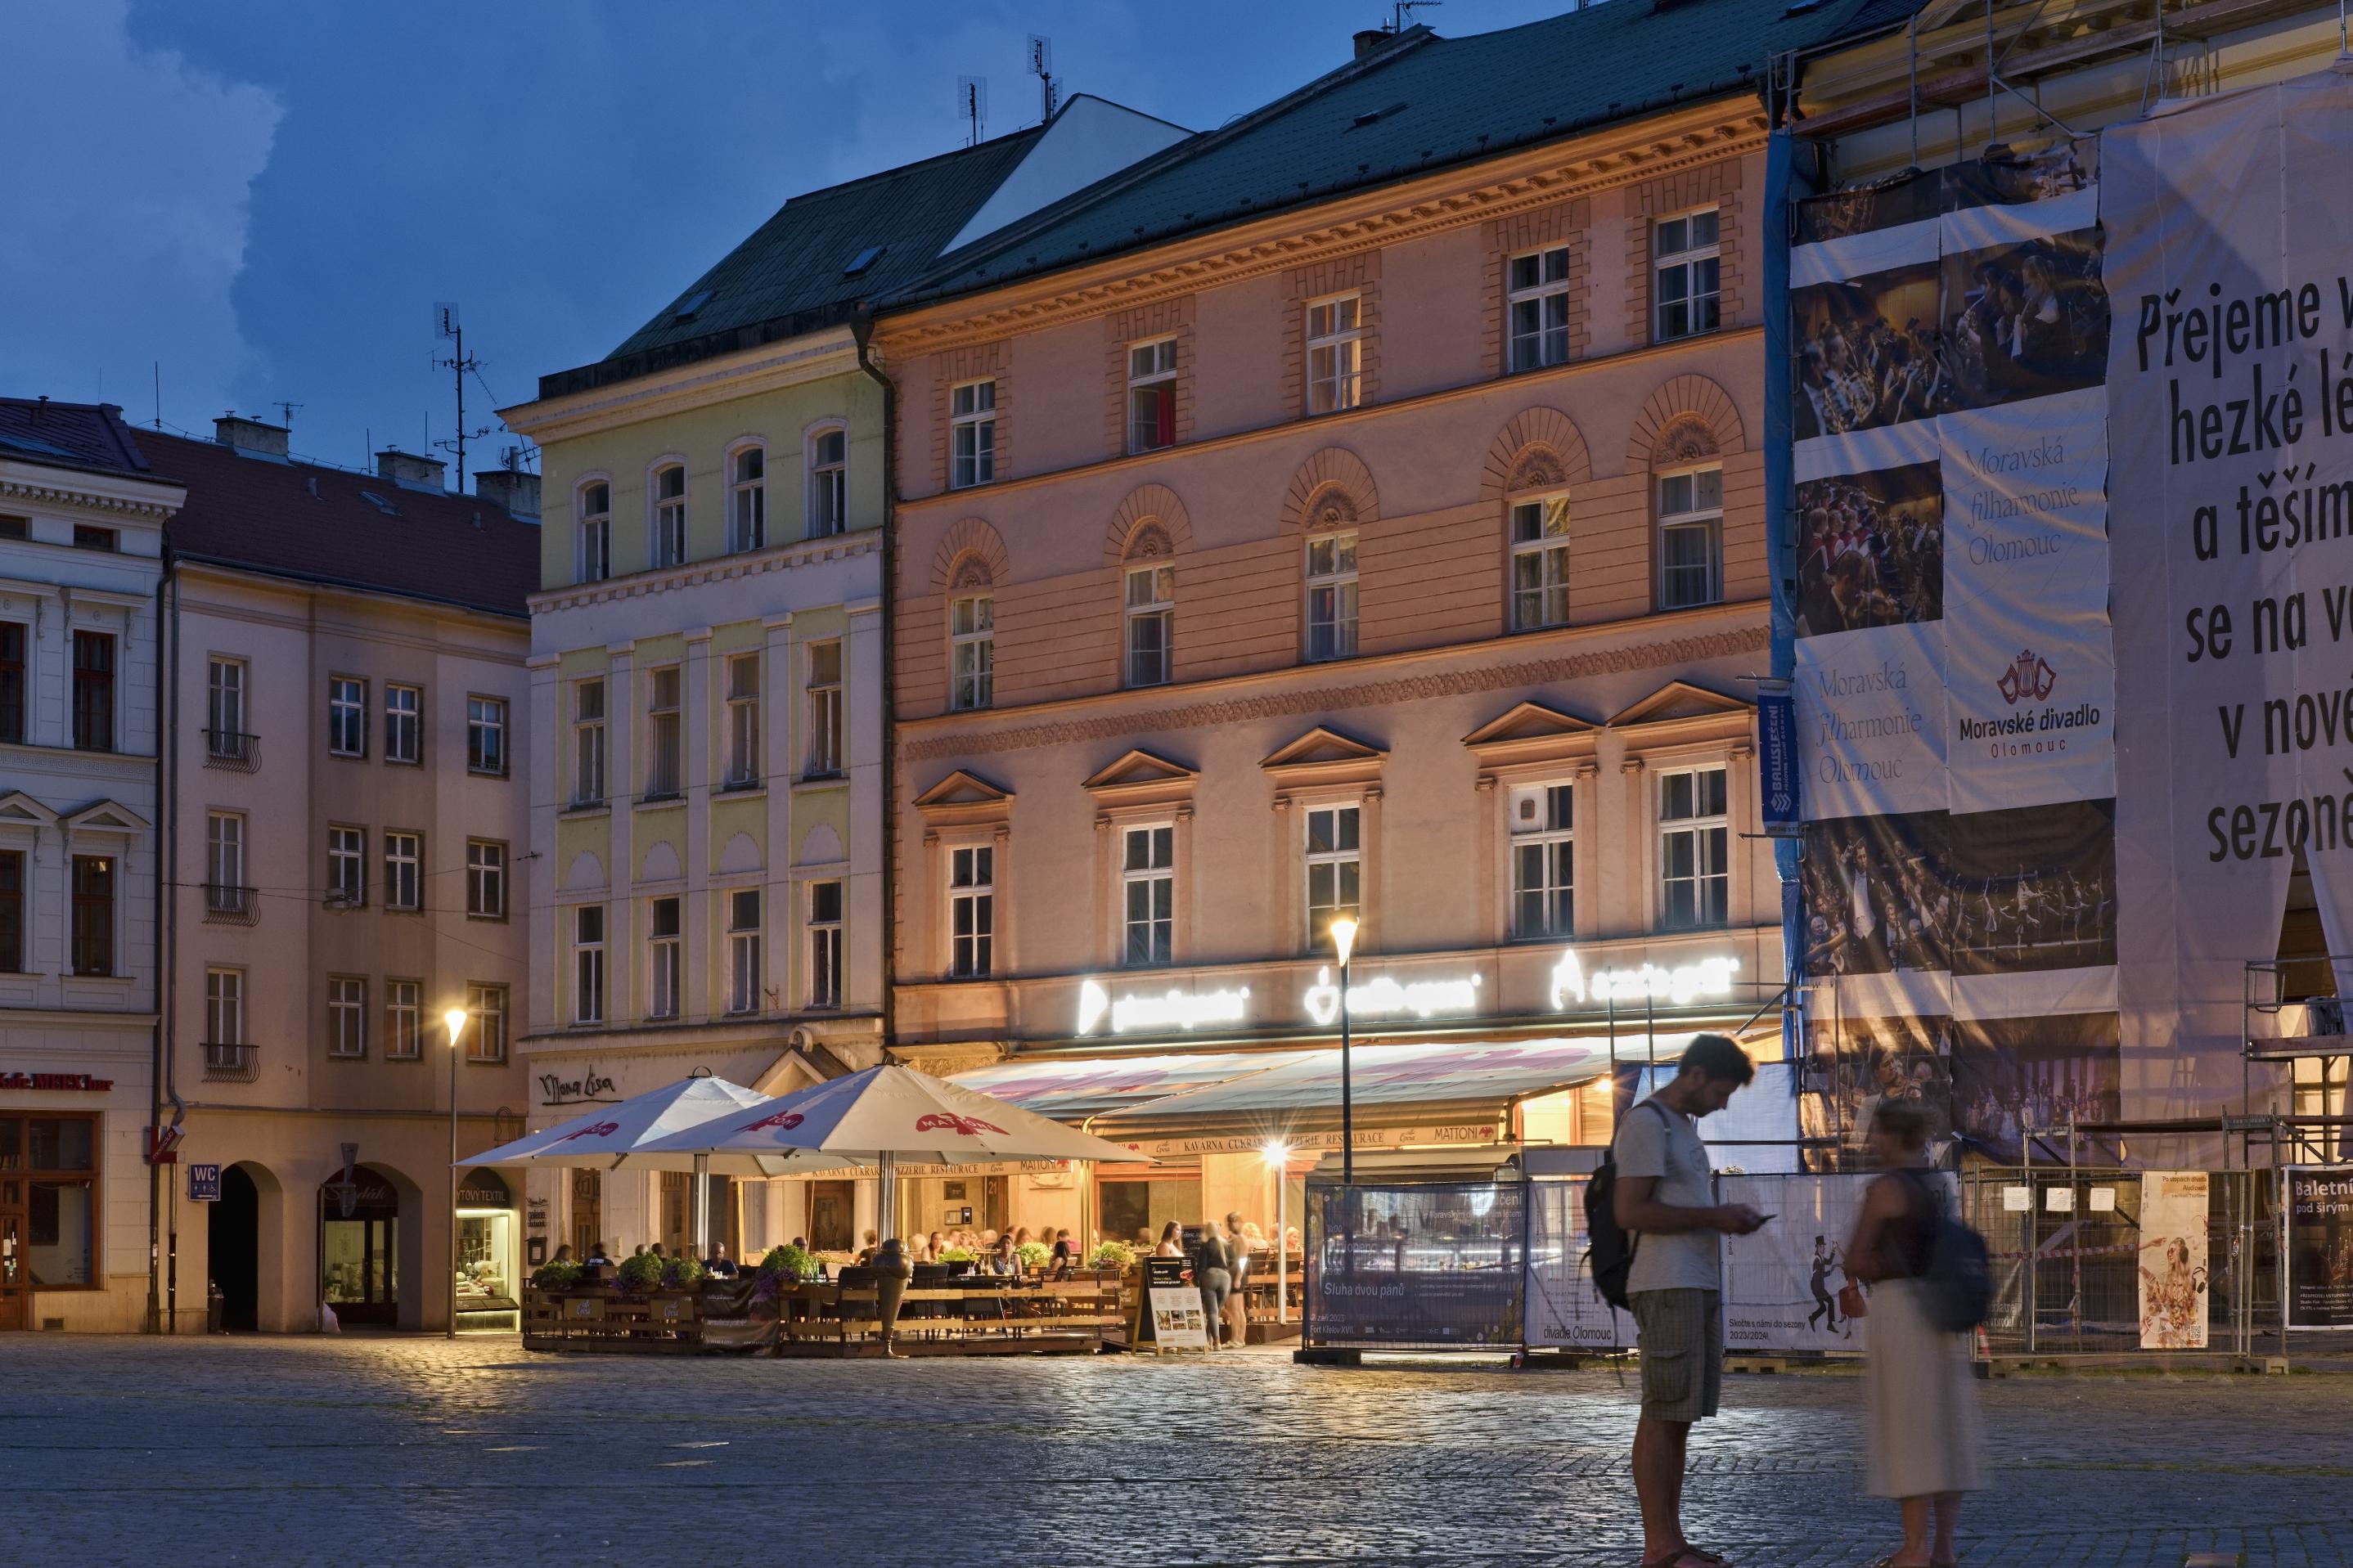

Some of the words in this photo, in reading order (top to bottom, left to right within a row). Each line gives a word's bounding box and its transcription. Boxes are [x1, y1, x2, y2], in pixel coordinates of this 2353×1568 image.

[2137, 282, 2320, 379] Přejeme
[2170, 363, 2303, 465] hezké
[1965, 435, 2063, 477] Moravská
[1968, 482, 2081, 529] filharmonie
[2193, 505, 2218, 561] a
[1969, 533, 2061, 565] Olomouc
[2186, 604, 2232, 663] se
[2253, 592, 2306, 654] na
[2323, 586, 2353, 641] v
[1819, 661, 1906, 698] Moravská
[1816, 708, 1922, 748] filharmonie
[1959, 709, 2034, 741] Moravské
[2040, 703, 2100, 730] divadlo
[2219, 704, 2244, 759] v
[1991, 739, 2066, 759] Olomouc
[1820, 756, 1904, 784] Olomouc
[83, 1073, 114, 1092] bar
[539, 1073, 582, 1103] Mona
[584, 1063, 615, 1097] Lisa
[922, 1116, 993, 1130] MATTONI
[1184, 1138, 1223, 1152] KAVÁRNA
[1228, 1134, 1265, 1150] CUKRÁR
[1285, 1134, 1320, 1147] IZZERIE
[1326, 1132, 1384, 1145] RESAURACE
[1434, 1127, 1477, 1140] MATTONI
[194, 1166, 216, 1181] WC
[931, 1164, 979, 1175] RESTAURACE
[1020, 1160, 1055, 1170] MATTONI
[457, 1188, 481, 1202] YTOVÝ
[482, 1188, 506, 1202] TEXTIL
[988, 1180, 997, 1194] 21
[2295, 1178, 2353, 1196] Baletní
[2297, 1202, 2314, 1215] pod
[2316, 1201, 2349, 1215] širým
[1324, 1282, 1352, 1296] Sluha
[1355, 1283, 1378, 1296] dvou
[1380, 1282, 1405, 1299] pánů
[1310, 1325, 1321, 1334] Fort
[1572, 1325, 1612, 1340] Olomouc
[1730, 1318, 1751, 1328] Skočte
[1757, 1319, 1772, 1328] námi
[1773, 1319, 1783, 1328] do
[1784, 1321, 1806, 1330] sezony
[1730, 1331, 1769, 1339] 2023/2024!
